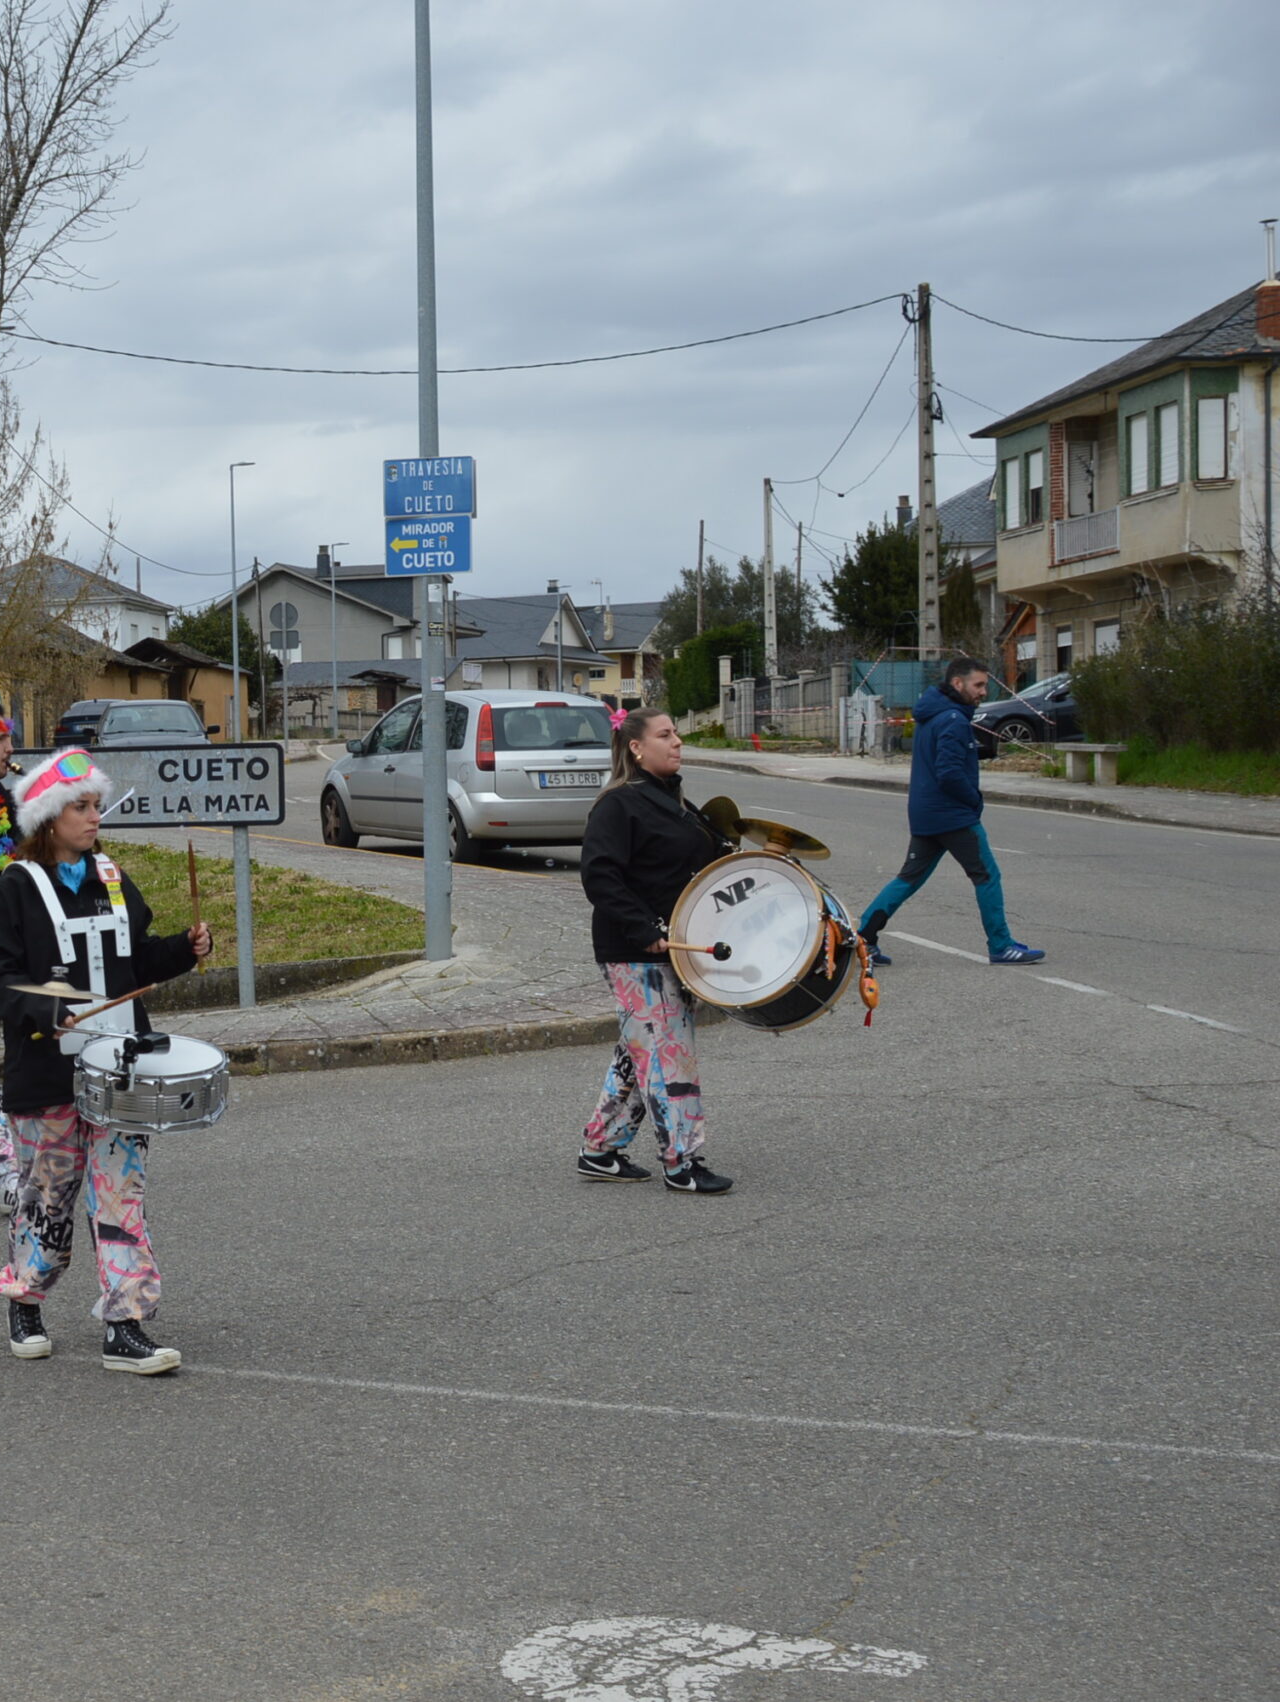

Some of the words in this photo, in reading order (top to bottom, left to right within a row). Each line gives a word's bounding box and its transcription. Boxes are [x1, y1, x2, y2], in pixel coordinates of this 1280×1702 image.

[423, 480, 434, 491] DE
[405, 494, 454, 513] CUETO
[402, 521, 454, 535] MIRADOR
[422, 538, 435, 548] DE
[402, 551, 455, 568] CUETO
[158, 756, 270, 783] CUETO
[547, 773, 575, 785] 4513
[578, 773, 598, 785] CRB
[120, 796, 151, 815] DE
[163, 795, 193, 814] LA
[205, 793, 270, 814] MATA
[710, 877, 756, 914] NP
